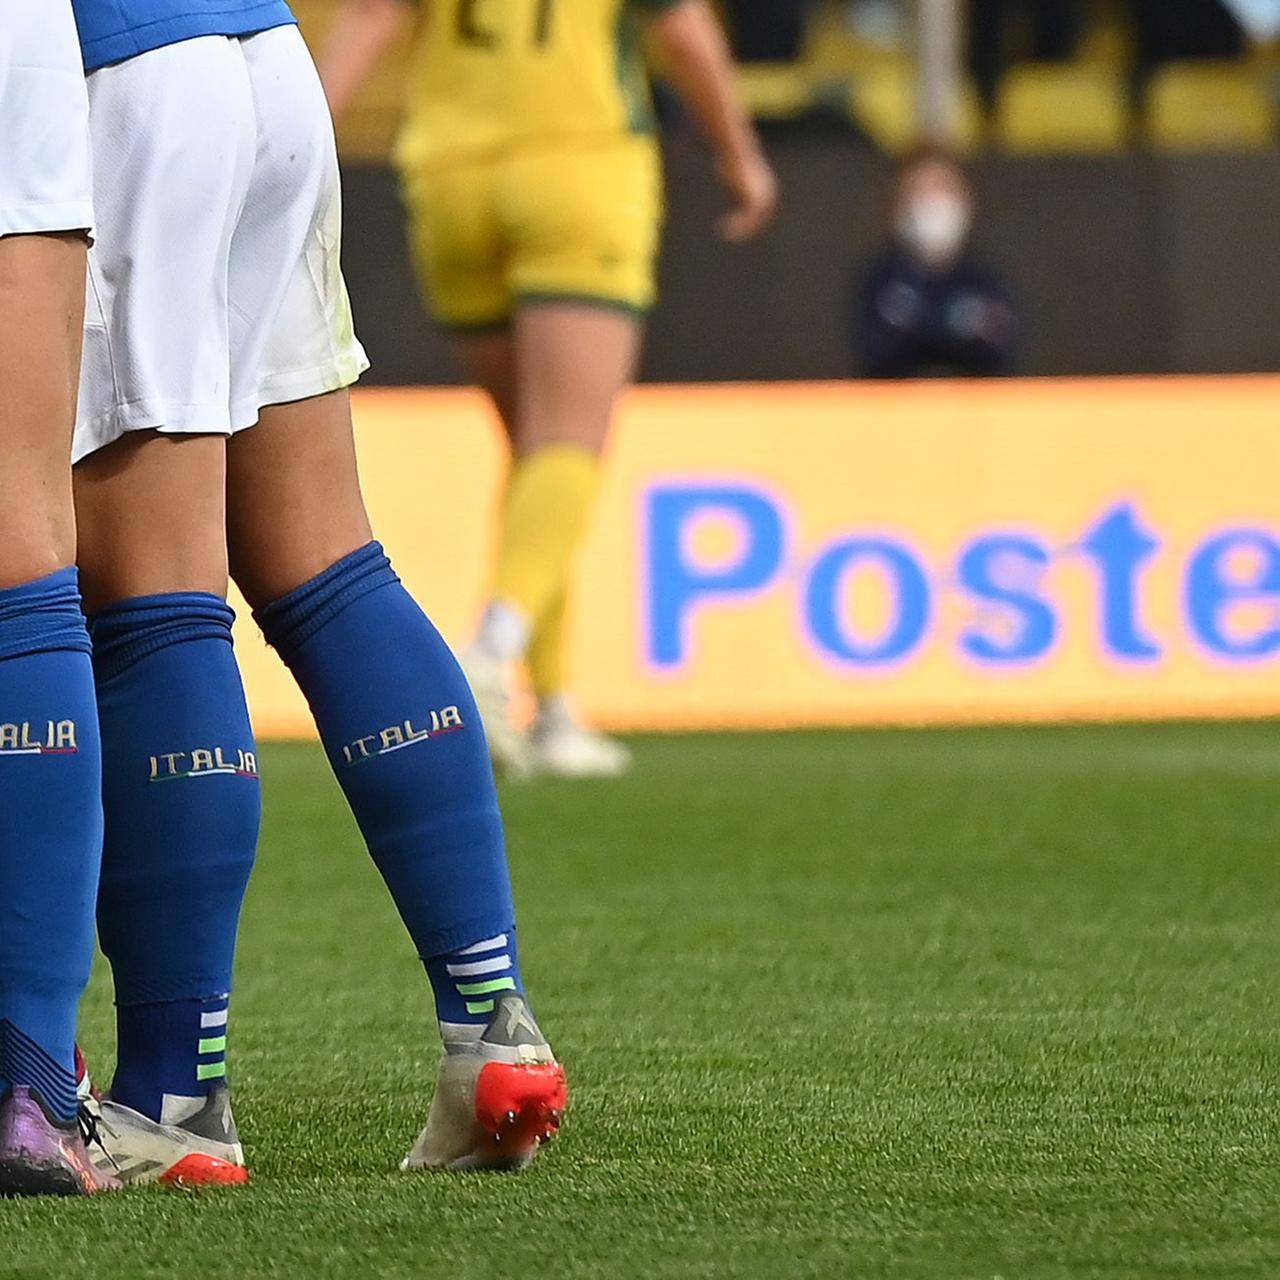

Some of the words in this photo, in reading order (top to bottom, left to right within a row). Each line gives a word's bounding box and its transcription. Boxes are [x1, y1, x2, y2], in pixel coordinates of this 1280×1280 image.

[646, 486, 1280, 665] Poste
[148, 748, 258, 778] ITALIA
[340, 705, 462, 763] ITALIA
